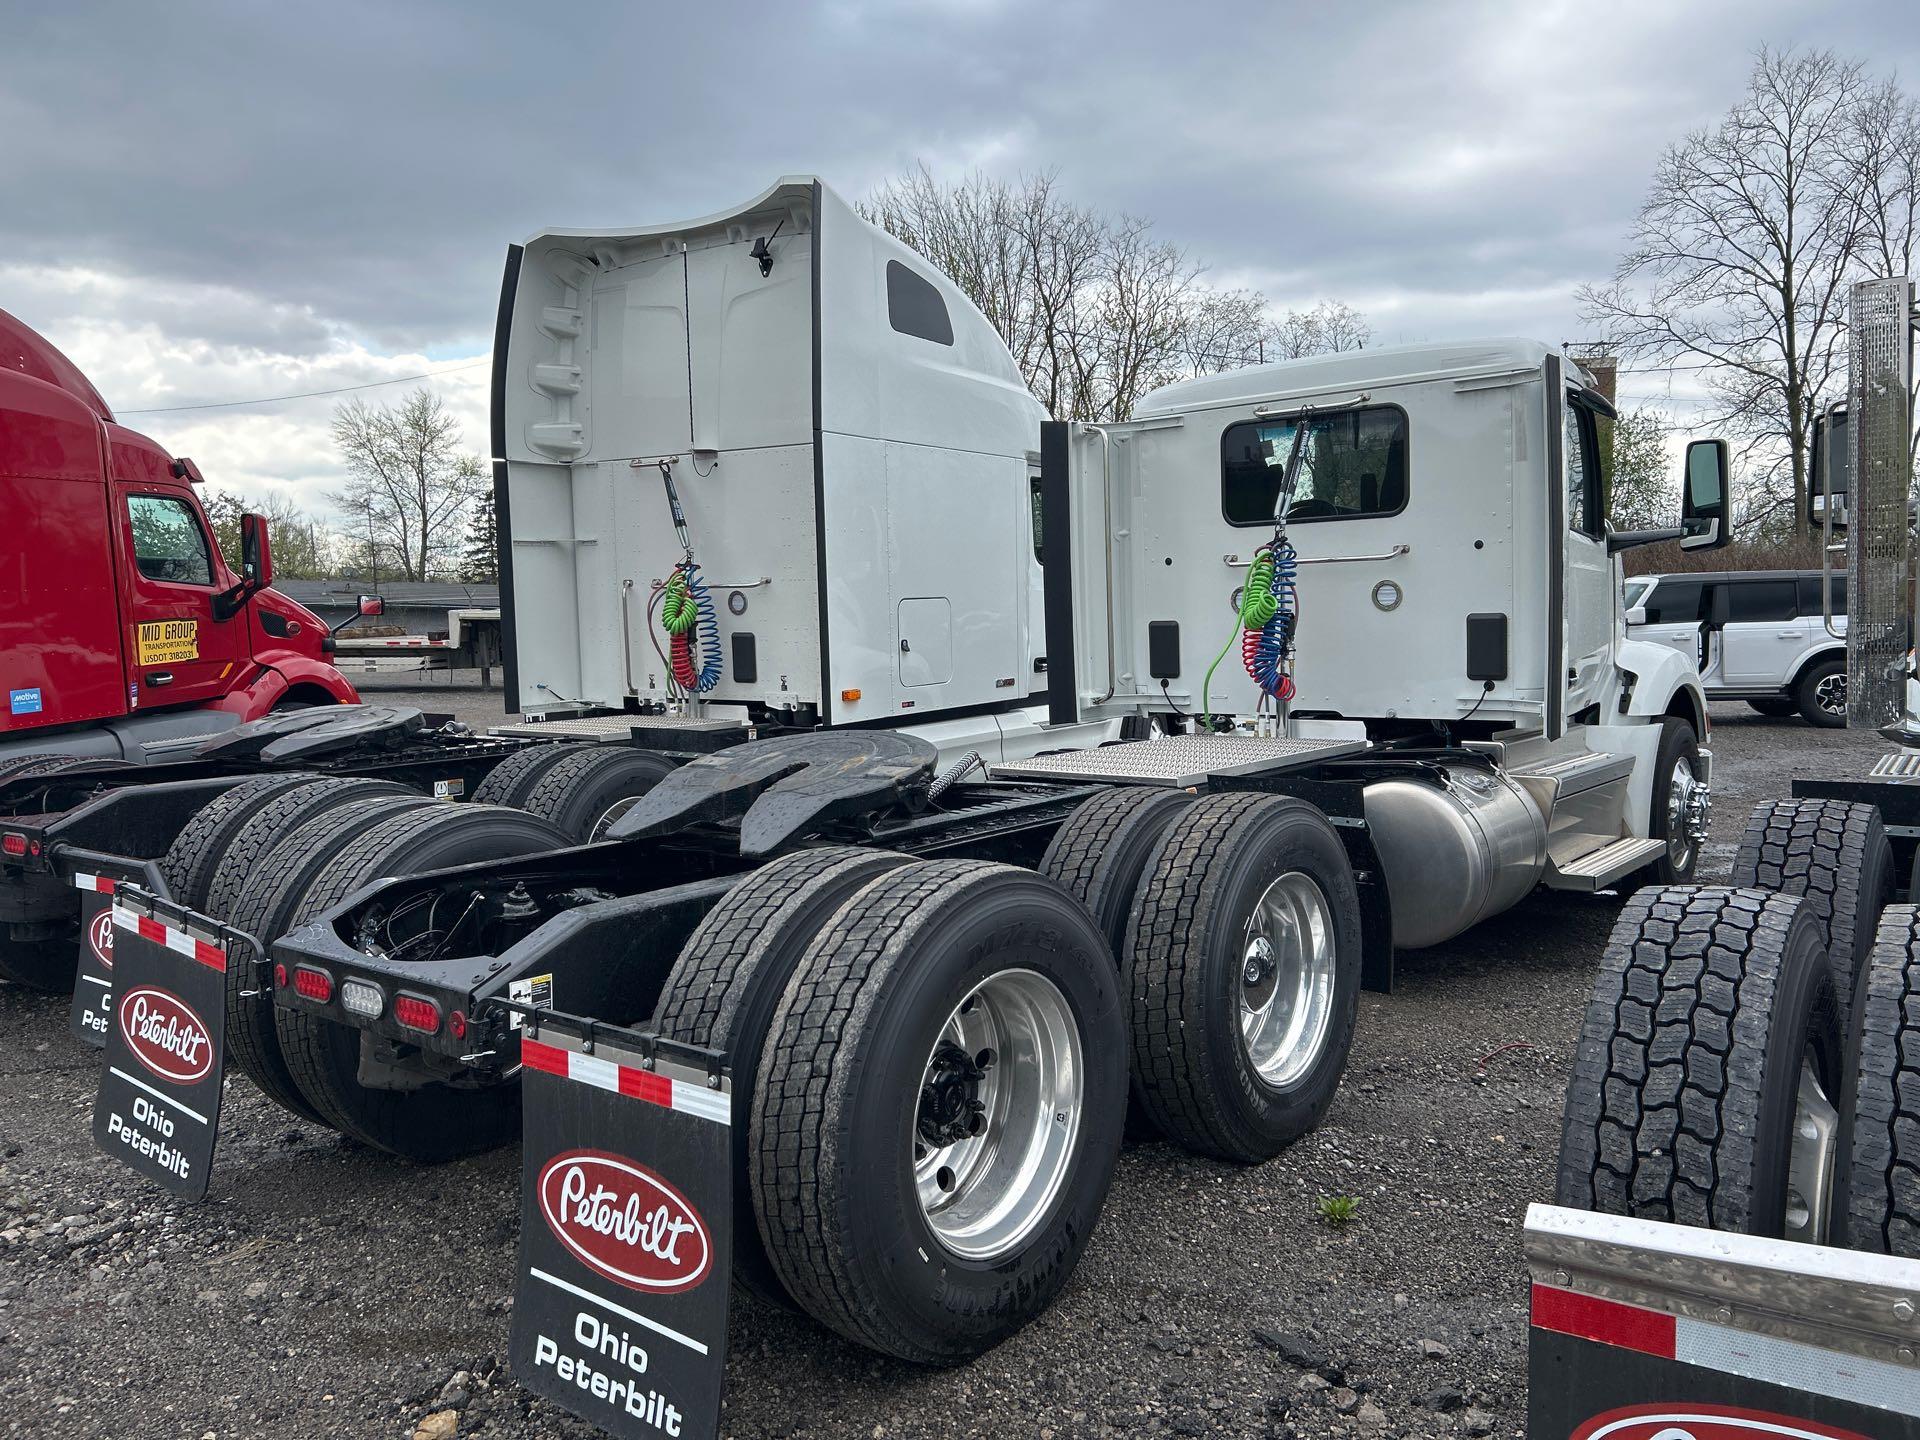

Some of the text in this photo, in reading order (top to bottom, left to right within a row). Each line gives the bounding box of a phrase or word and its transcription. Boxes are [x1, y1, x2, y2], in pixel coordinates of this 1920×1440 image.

[142, 622, 195, 642] MID GROUP
[144, 653, 167, 663] USDOT
[131, 996, 205, 1065] Peterbilt
[108, 1112, 190, 1179] Peterbilt
[132, 1097, 174, 1138] Ohio
[561, 1166, 694, 1265] Peterbilt
[574, 1312, 648, 1374] Ohio
[534, 1334, 683, 1438] Peterbilt
